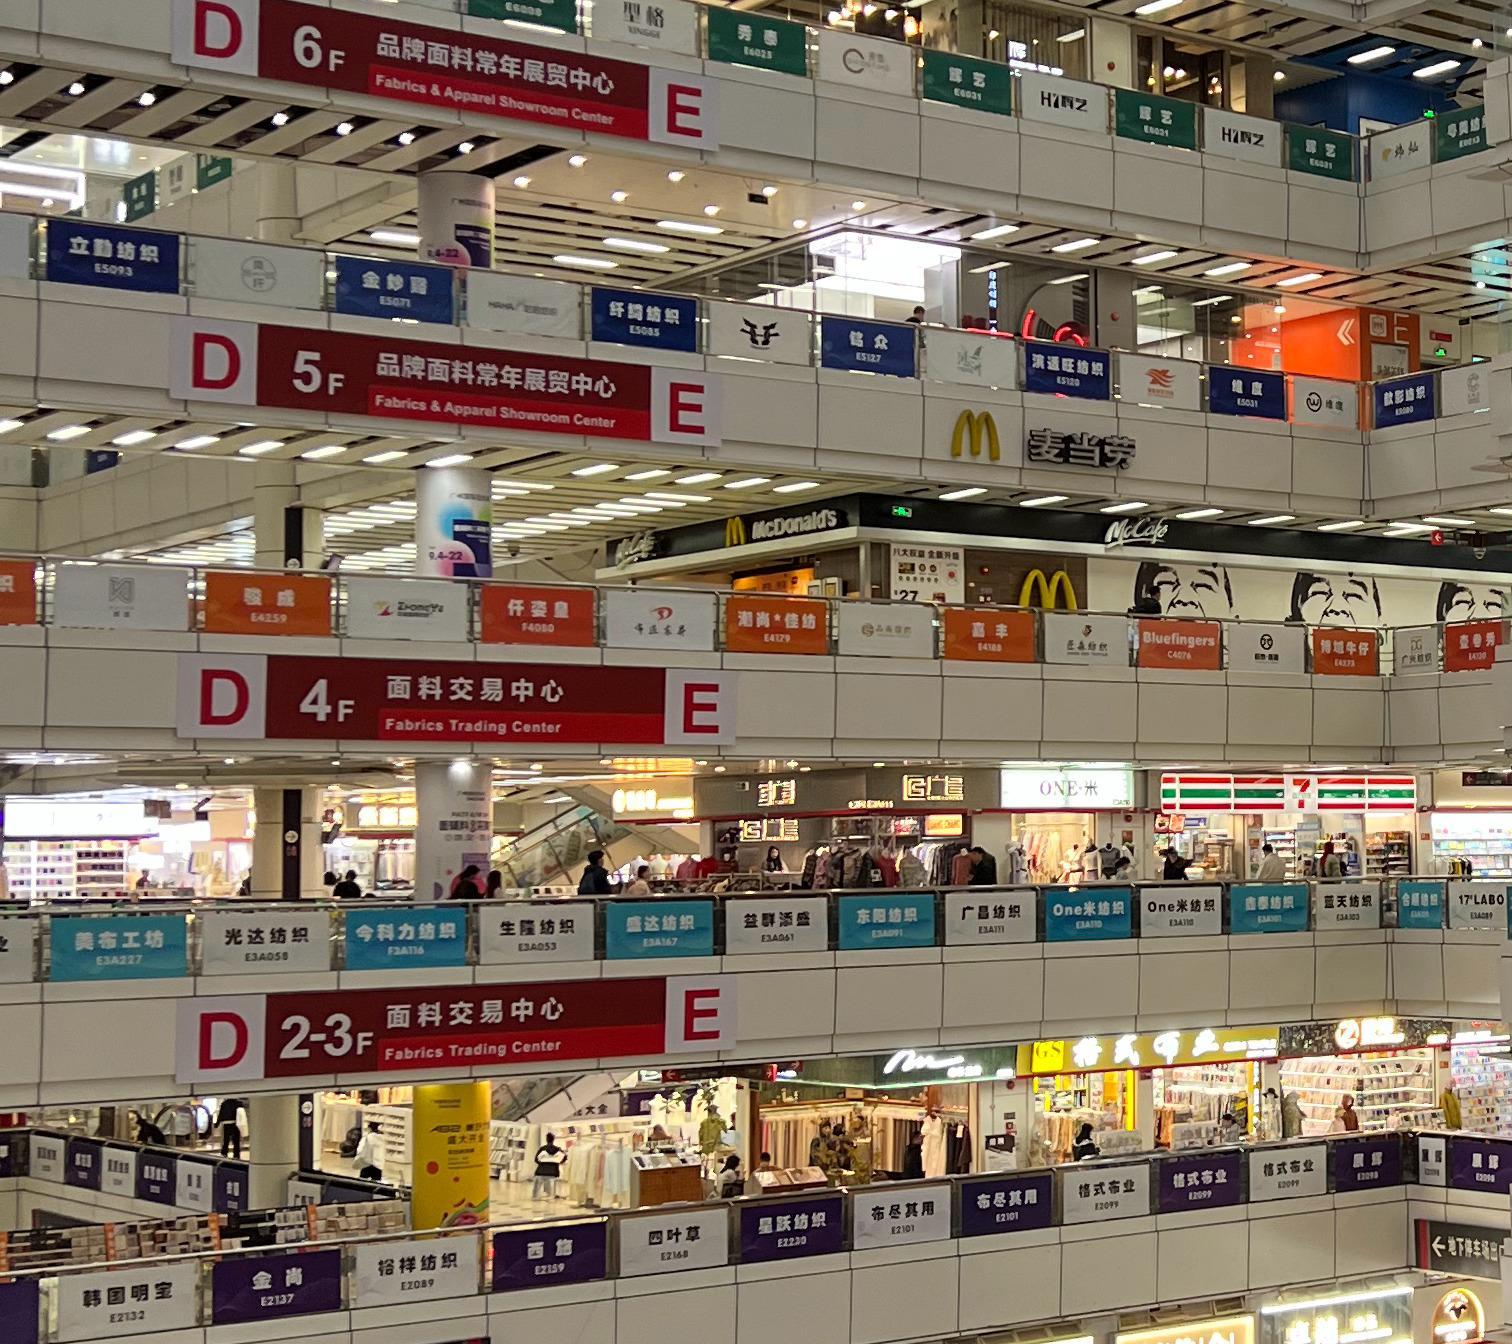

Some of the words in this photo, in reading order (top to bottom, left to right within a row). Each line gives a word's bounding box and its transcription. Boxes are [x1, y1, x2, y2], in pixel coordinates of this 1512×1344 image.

[194, 0, 243, 58] D
[294, 24, 346, 72] 6F
[377, 32, 615, 95] 品牌面料常年展贸中心
[376, 74, 428, 95] Fabrics
[431, 83, 441, 97] &
[444, 84, 497, 110] Apparel
[499, 96, 567, 121] Showroom
[570, 107, 615, 127] Center
[667, 83, 702, 137] E
[94, 263, 134, 278] E5093
[192, 333, 242, 390] D
[293, 351, 345, 396] 5F
[377, 353, 616, 399] 品牌面料常年展贸中心
[375, 393, 428, 412] Fabrics
[431, 399, 441, 413] &
[444, 401, 497, 422] Apparel
[500, 405, 570, 425] Showroom
[573, 413, 616, 429] Center
[669, 383, 705, 435] E
[1027, 428, 1137, 470] 麦当劳
[752, 509, 838, 540] McDonald's
[250, 612, 288, 624] E4259
[1142, 631, 1216, 649] Bluefingers
[200, 669, 250, 725] D
[299, 679, 355, 722] 4F
[386, 676, 565, 704] 面料交易中心
[683, 683, 719, 733] E
[385, 717, 444, 732] Fabrics
[450, 718, 507, 735] Trading
[512, 719, 561, 734] Center
[961, 903, 1022, 921] 广昌纺织
[1052, 899, 1126, 918] One米纺织
[1147, 897, 1217, 914] One米纺织
[1323, 893, 1374, 910] 蓝天纺织
[355, 920, 457, 942] 今科力纺织
[500, 918, 575, 936] 生隆纺织
[625, 914, 695, 933] 盛达纺织
[743, 910, 812, 930] 益群添盛
[74, 930, 165, 951] 美布工坊
[224, 925, 310, 945] 光达纺织
[386, 997, 565, 1029] 面料交易中心
[684, 989, 720, 1040] E
[199, 1013, 249, 1069] D
[280, 1013, 374, 1060] 2-3F
[385, 1044, 444, 1061] Fabrics
[450, 1042, 507, 1060] Trading
[512, 1039, 561, 1055] Center
[1264, 1159, 1314, 1177] 格式布业
[1079, 1179, 1135, 1199] 格式布业
[1173, 1170, 1227, 1189] 格式布业
[977, 1189, 1037, 1210] 布尽其用
[871, 1201, 934, 1222] 布尽其用
[758, 1211, 827, 1235] 星跃纺织
[648, 1225, 701, 1246] 四叶草
[252, 1267, 303, 1291] 金尚
[400, 1277, 435, 1291] E2089
[82, 1282, 173, 1308] 韩国明宝
[260, 1293, 295, 1307] E2137
[109, 1309, 145, 1323] E2132
